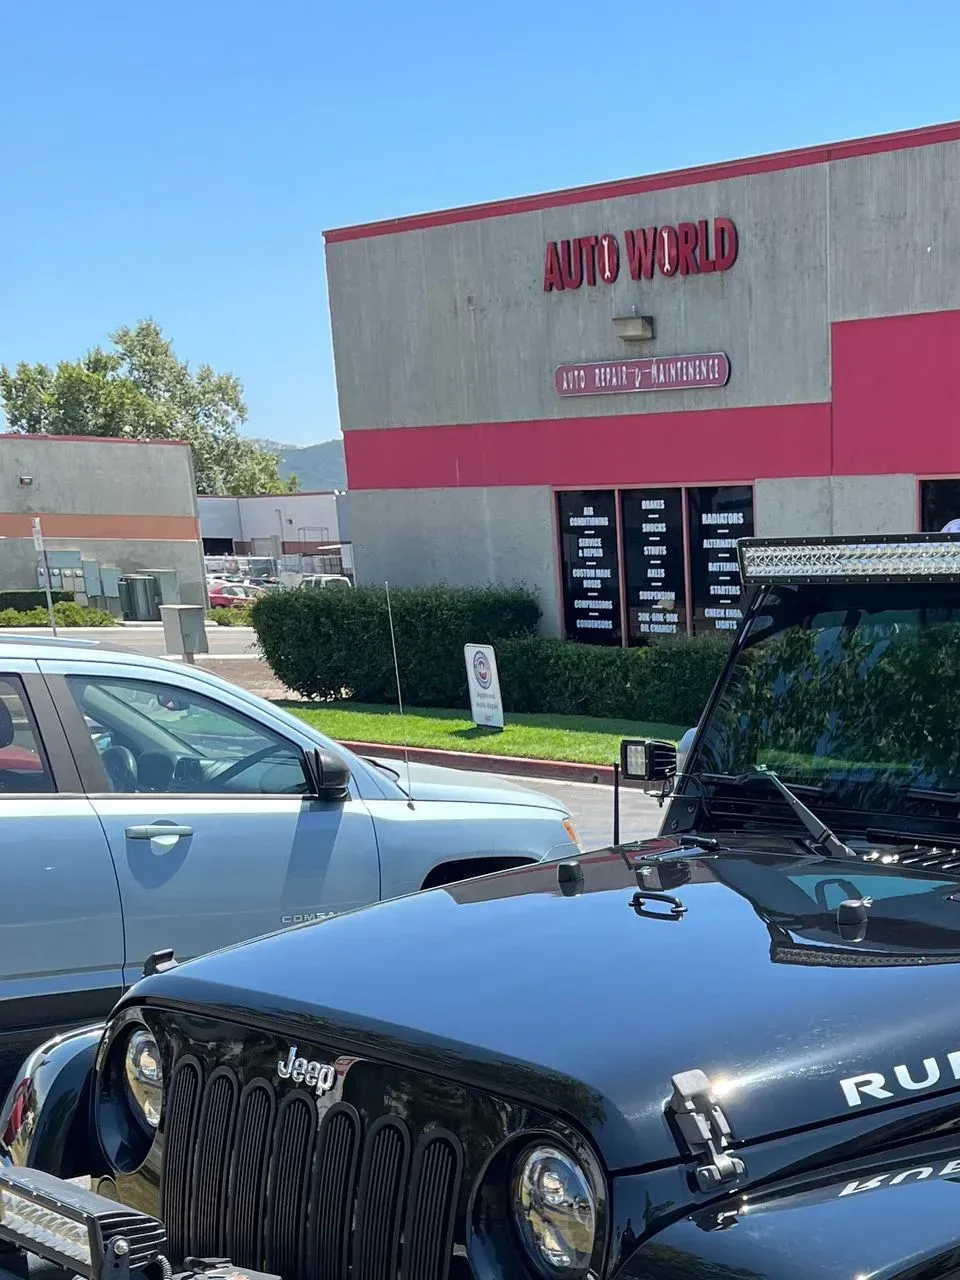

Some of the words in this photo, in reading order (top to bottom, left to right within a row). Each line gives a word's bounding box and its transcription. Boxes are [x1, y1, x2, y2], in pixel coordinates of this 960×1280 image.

[544, 234, 619, 291] AUTO
[624, 217, 739, 281] WORLD
[562, 369, 586, 390] AUTO
[595, 366, 627, 387] REPAIR
[702, 513, 743, 524] RADIATORS
[578, 538, 602, 547] SERVICE
[277, 1046, 334, 1096] Jeep
